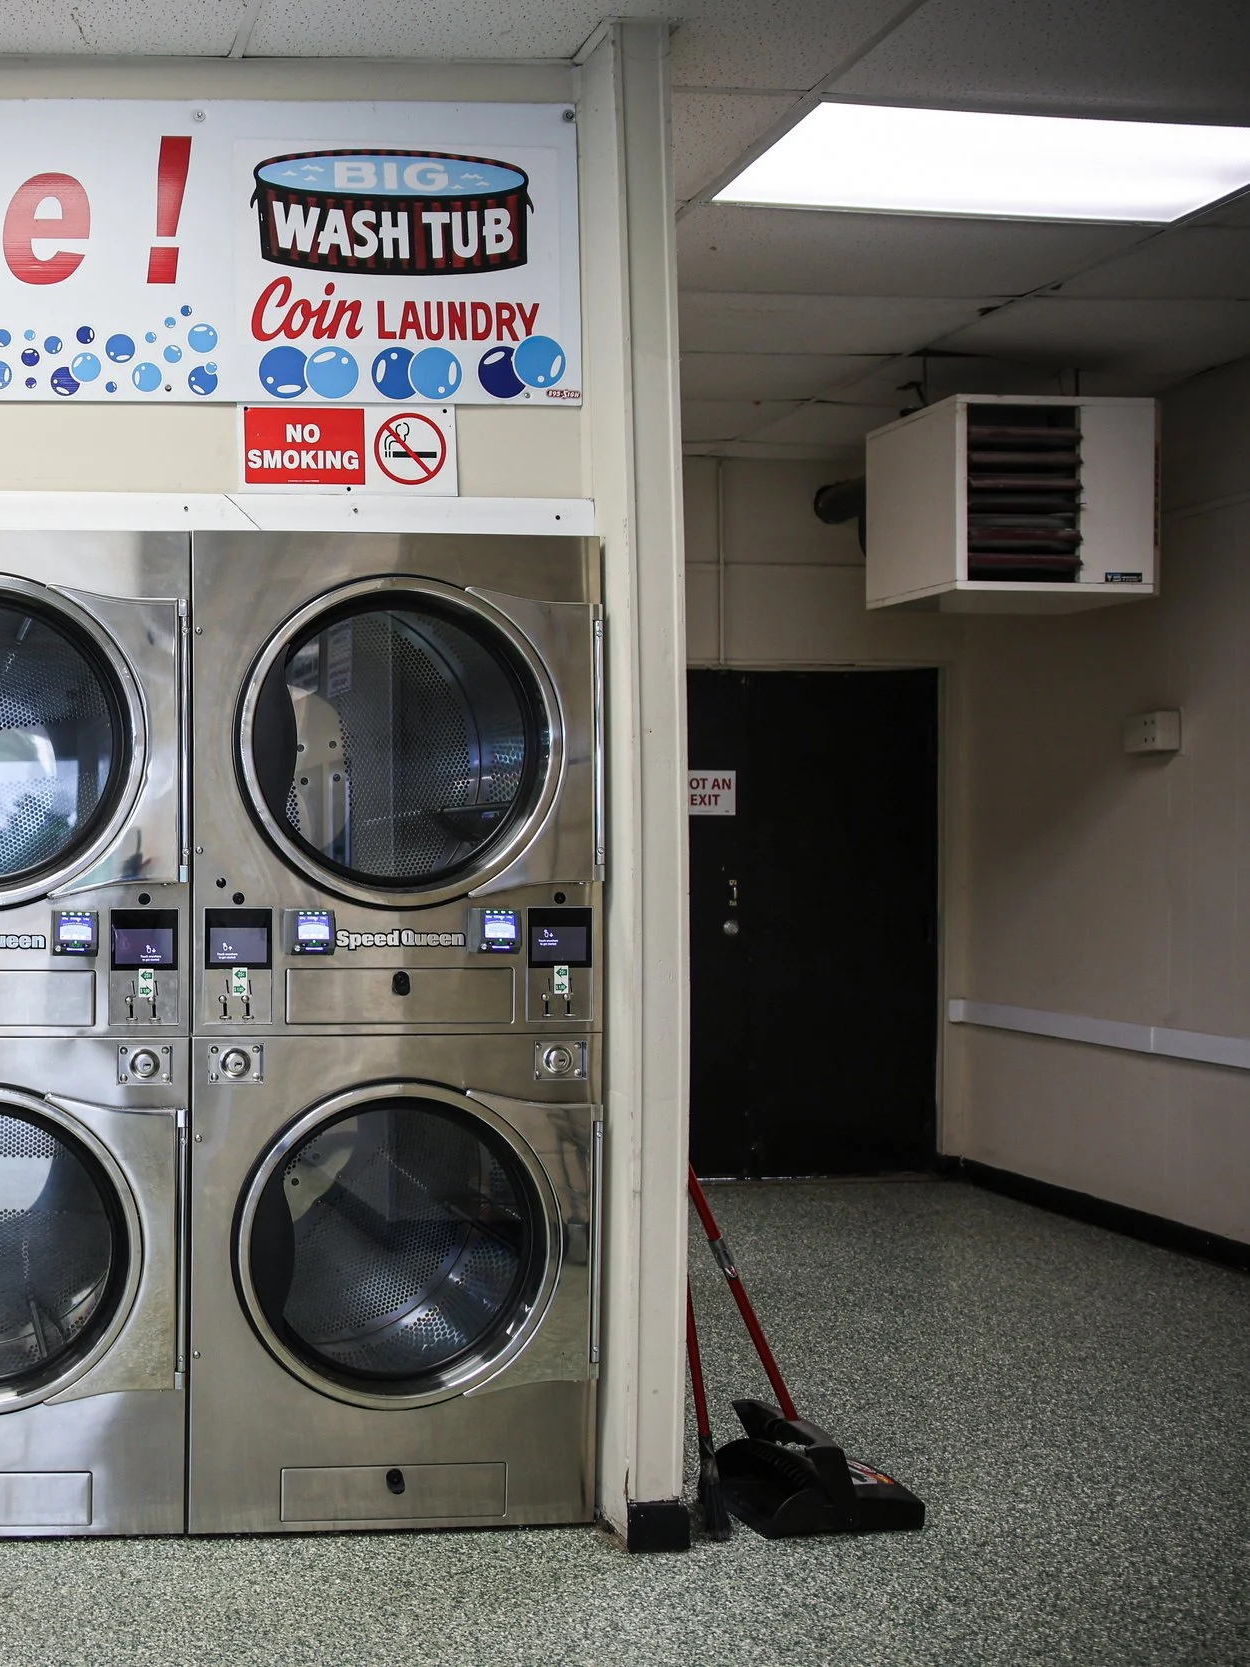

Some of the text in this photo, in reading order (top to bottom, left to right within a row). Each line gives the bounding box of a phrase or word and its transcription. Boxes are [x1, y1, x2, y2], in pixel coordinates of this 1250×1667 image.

[333, 160, 451, 192] BIG
[146, 135, 193, 285] !
[271, 200, 516, 261] WASH TUB
[250, 274, 541, 344] Coin LAUNDRY
[284, 423, 321, 445] NO
[246, 448, 360, 471] SMOKING
[688, 778, 732, 790] OT AN
[690, 794, 720, 806] EXIT
[336, 929, 466, 951] Speed Queen
